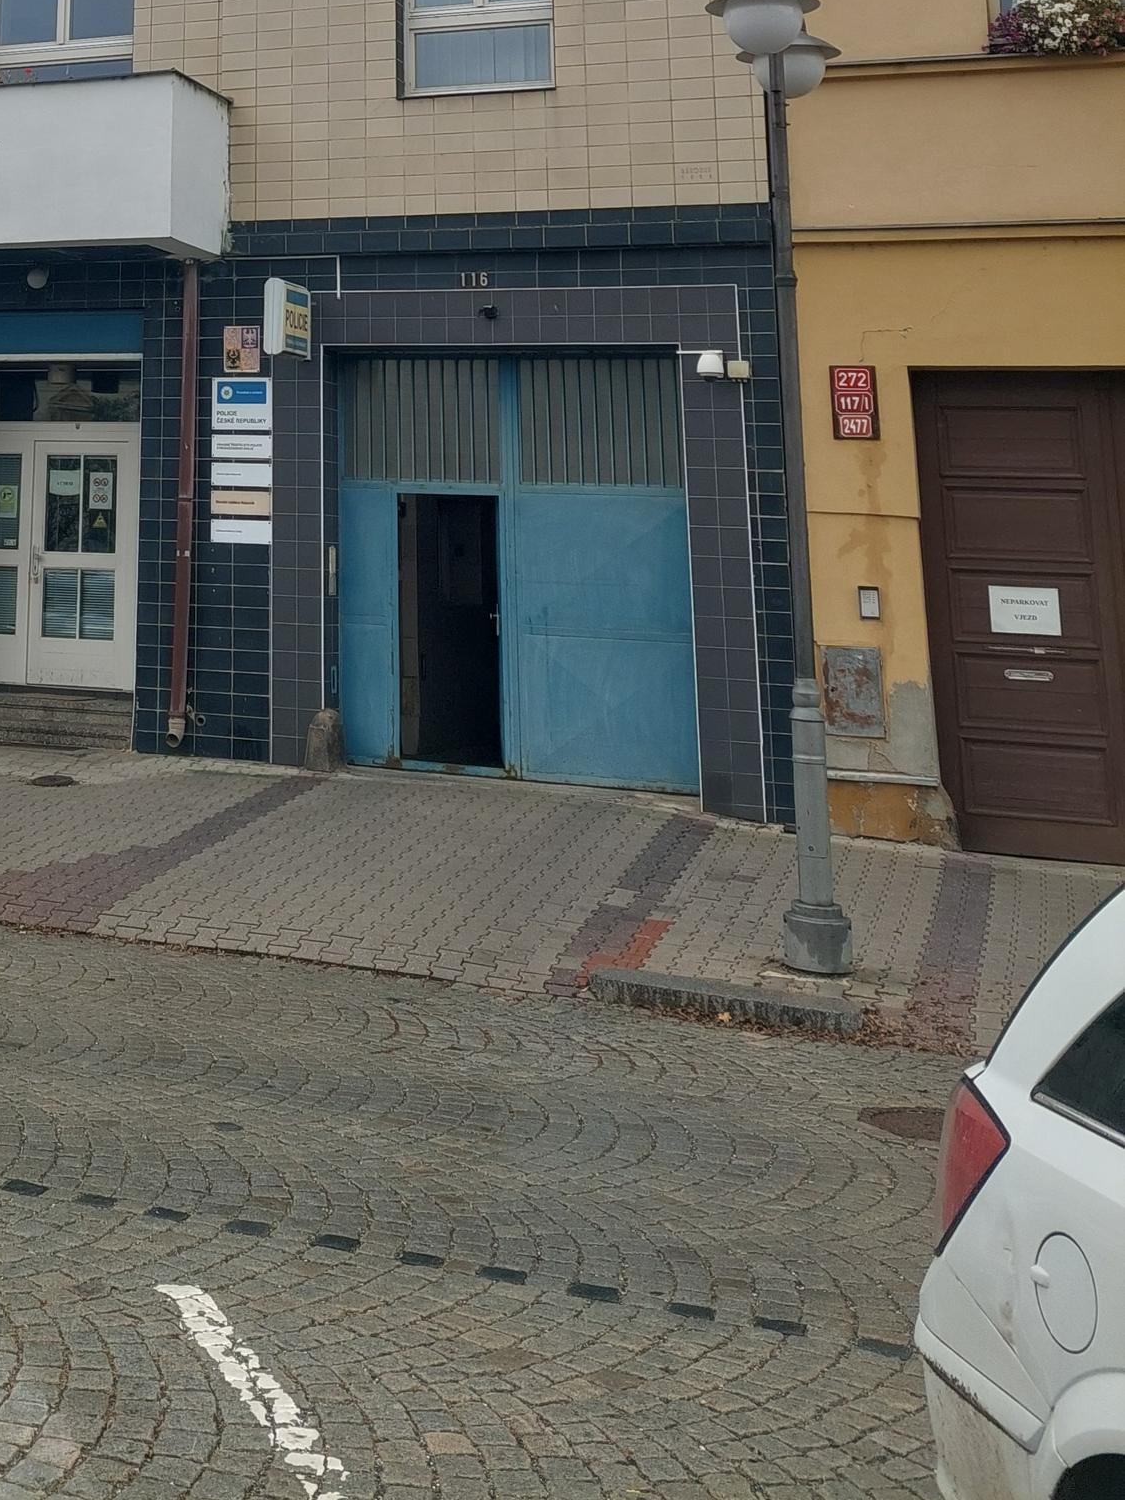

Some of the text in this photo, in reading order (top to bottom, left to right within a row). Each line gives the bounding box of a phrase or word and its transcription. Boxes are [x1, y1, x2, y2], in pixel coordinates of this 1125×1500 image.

[461, 272, 488, 287] 116
[286, 309, 308, 332] POLICIE
[838, 372, 867, 387] 272
[843, 419, 868, 434] 2477
[1000, 598, 1049, 607] NEPARKOVAT
